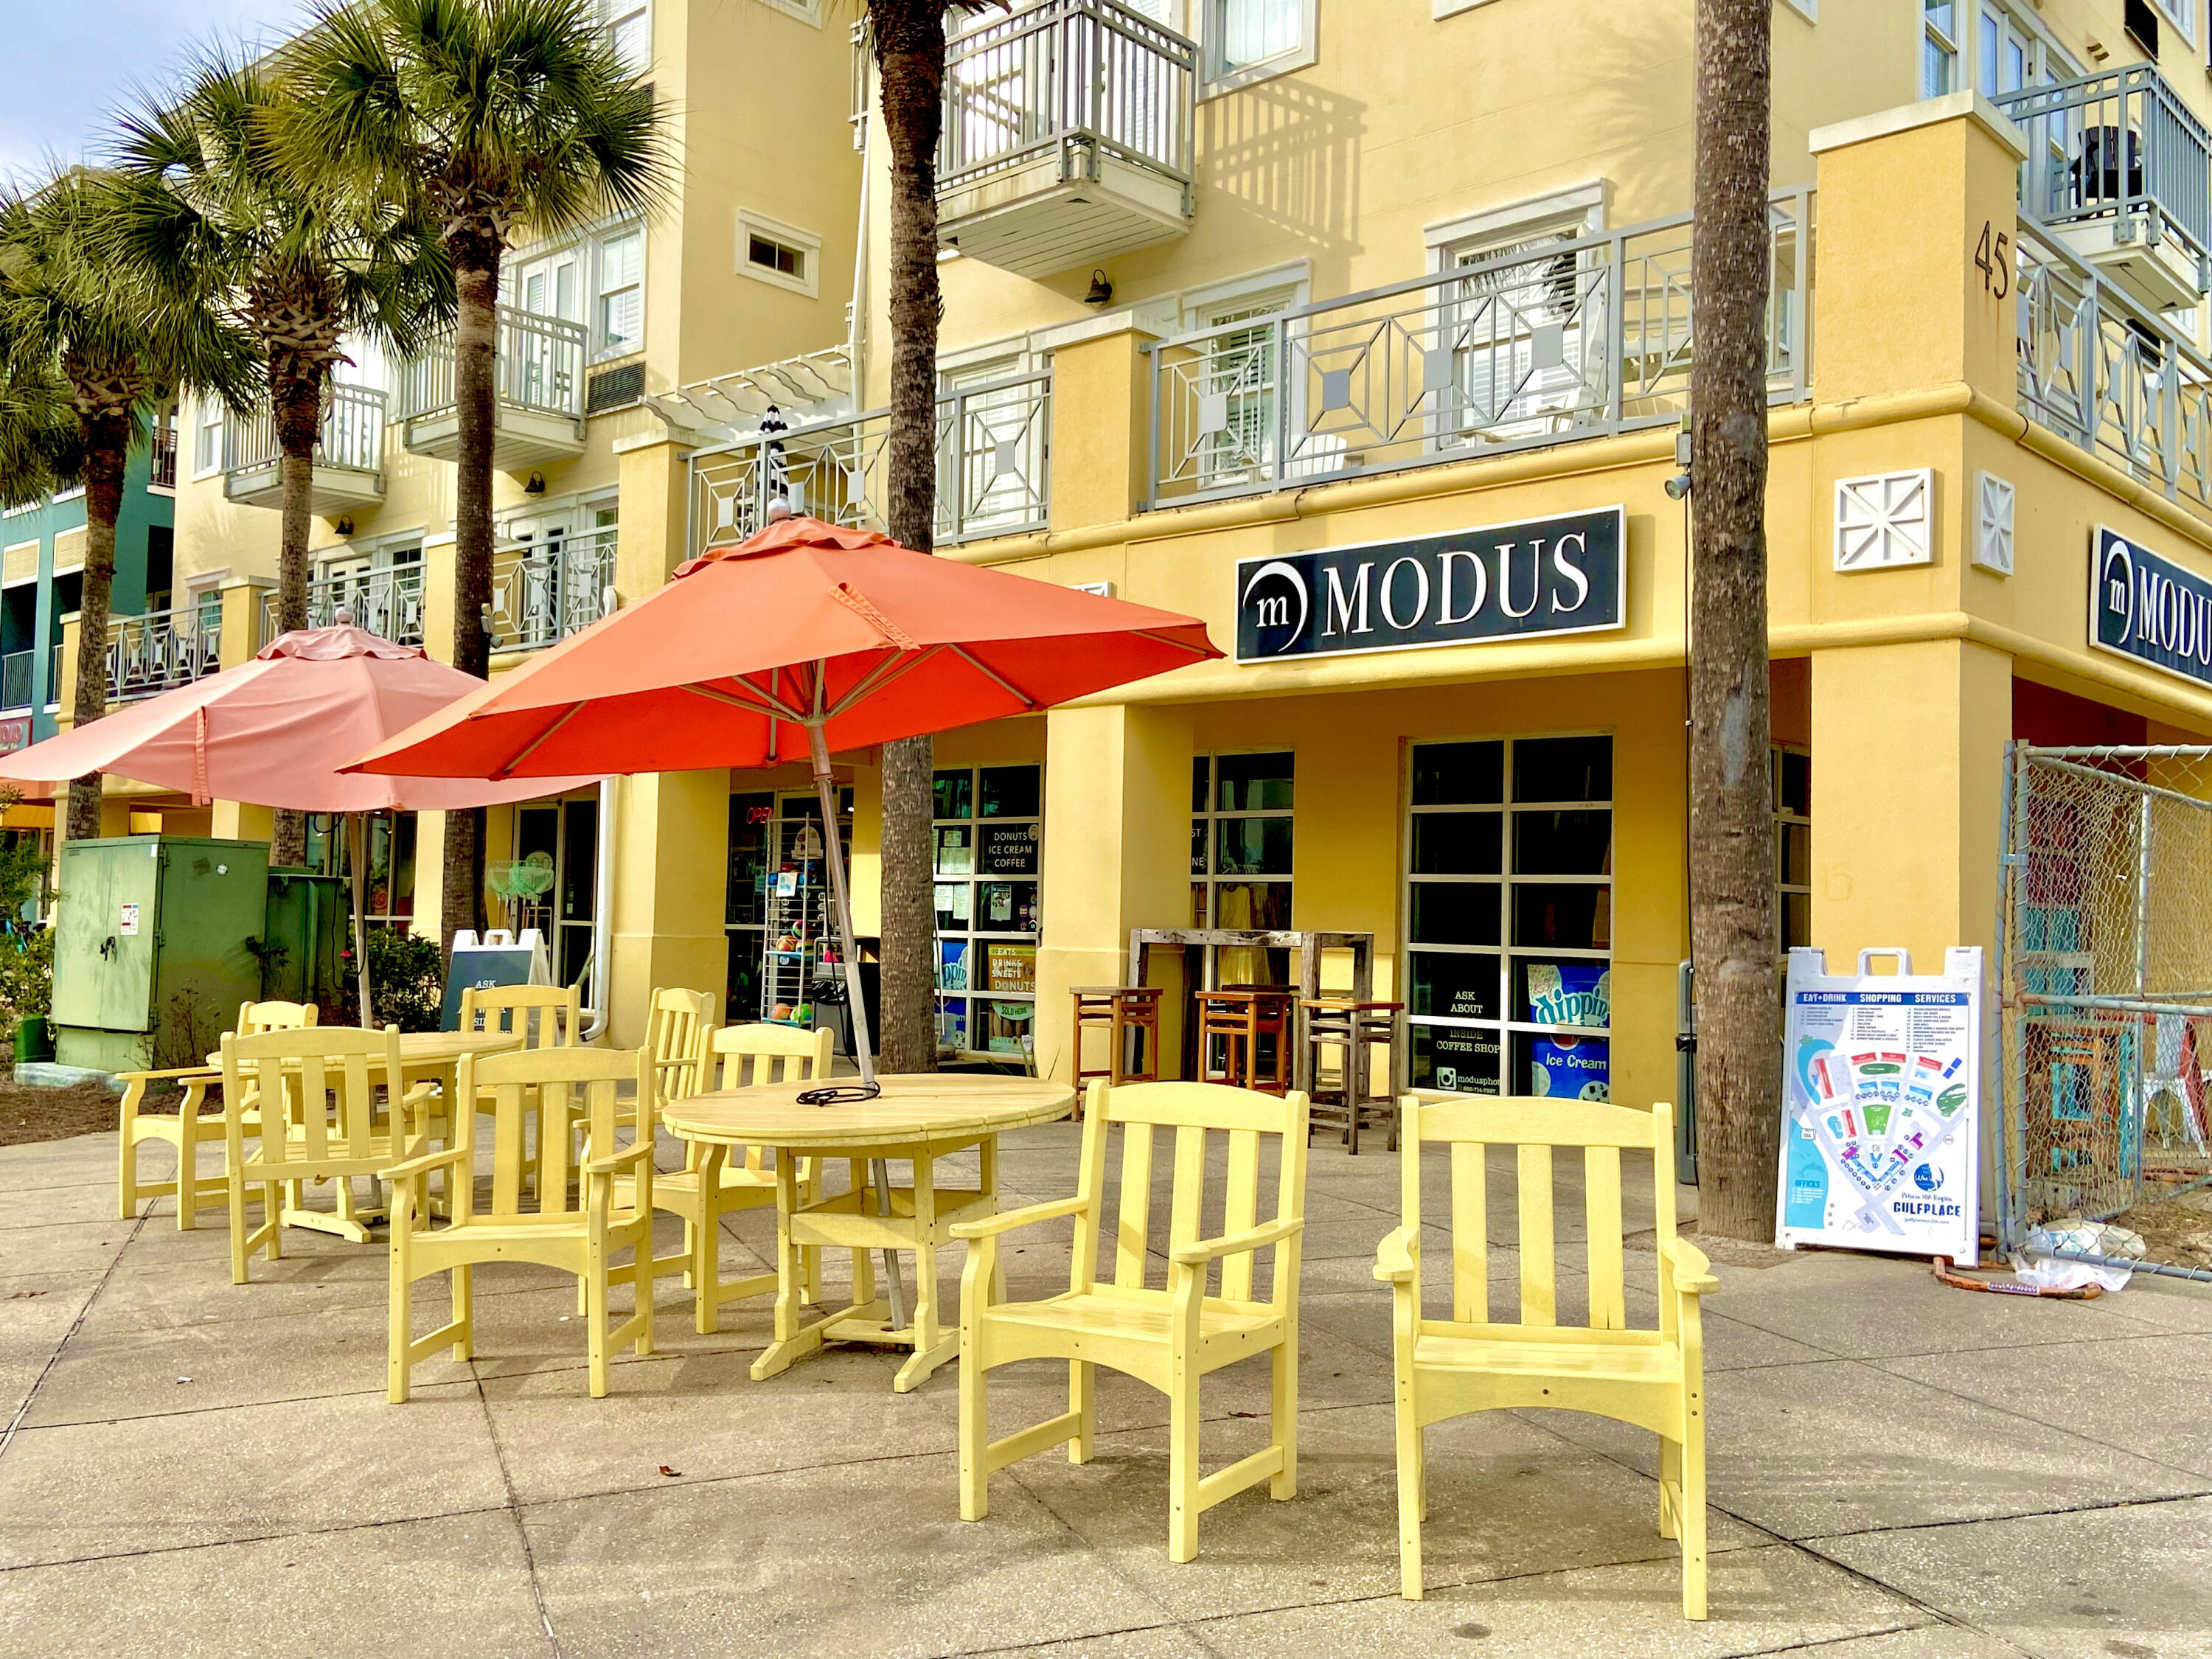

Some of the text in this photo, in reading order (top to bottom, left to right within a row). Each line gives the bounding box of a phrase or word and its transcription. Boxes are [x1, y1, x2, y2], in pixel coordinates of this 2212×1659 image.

[1975, 220, 2008, 299] 45
[1321, 532, 1589, 637] MODUS
[994, 832, 1027, 841] DONUTS
[989, 845, 1032, 854] ICE CREAM
[994, 858, 1026, 868] COFFEE
[998, 947, 1016, 956] EATS
[992, 959, 1022, 968] DRINKS
[992, 970, 1021, 978] SWEETS
[475, 980, 497, 989] ASK
[994, 980, 1036, 992] DONUTS
[1455, 991, 1475, 1001] ASK
[1860, 993, 1902, 1003] SHOPPING
[1915, 994, 1956, 1003] SERVICES
[1002, 1006, 1028, 1015] SOLD HERE
[1450, 1004, 1484, 1014] ABOUT
[1536, 988, 1607, 1024] dippin
[1450, 1029, 1484, 1040] INSIDE
[1436, 1040, 1500, 1054] COFFEE SHOP
[1545, 1053, 1607, 1070] Ice Cream
[1795, 1179, 1820, 1188] OFFICES
[1893, 1201, 1961, 1217] GULFPLACE
